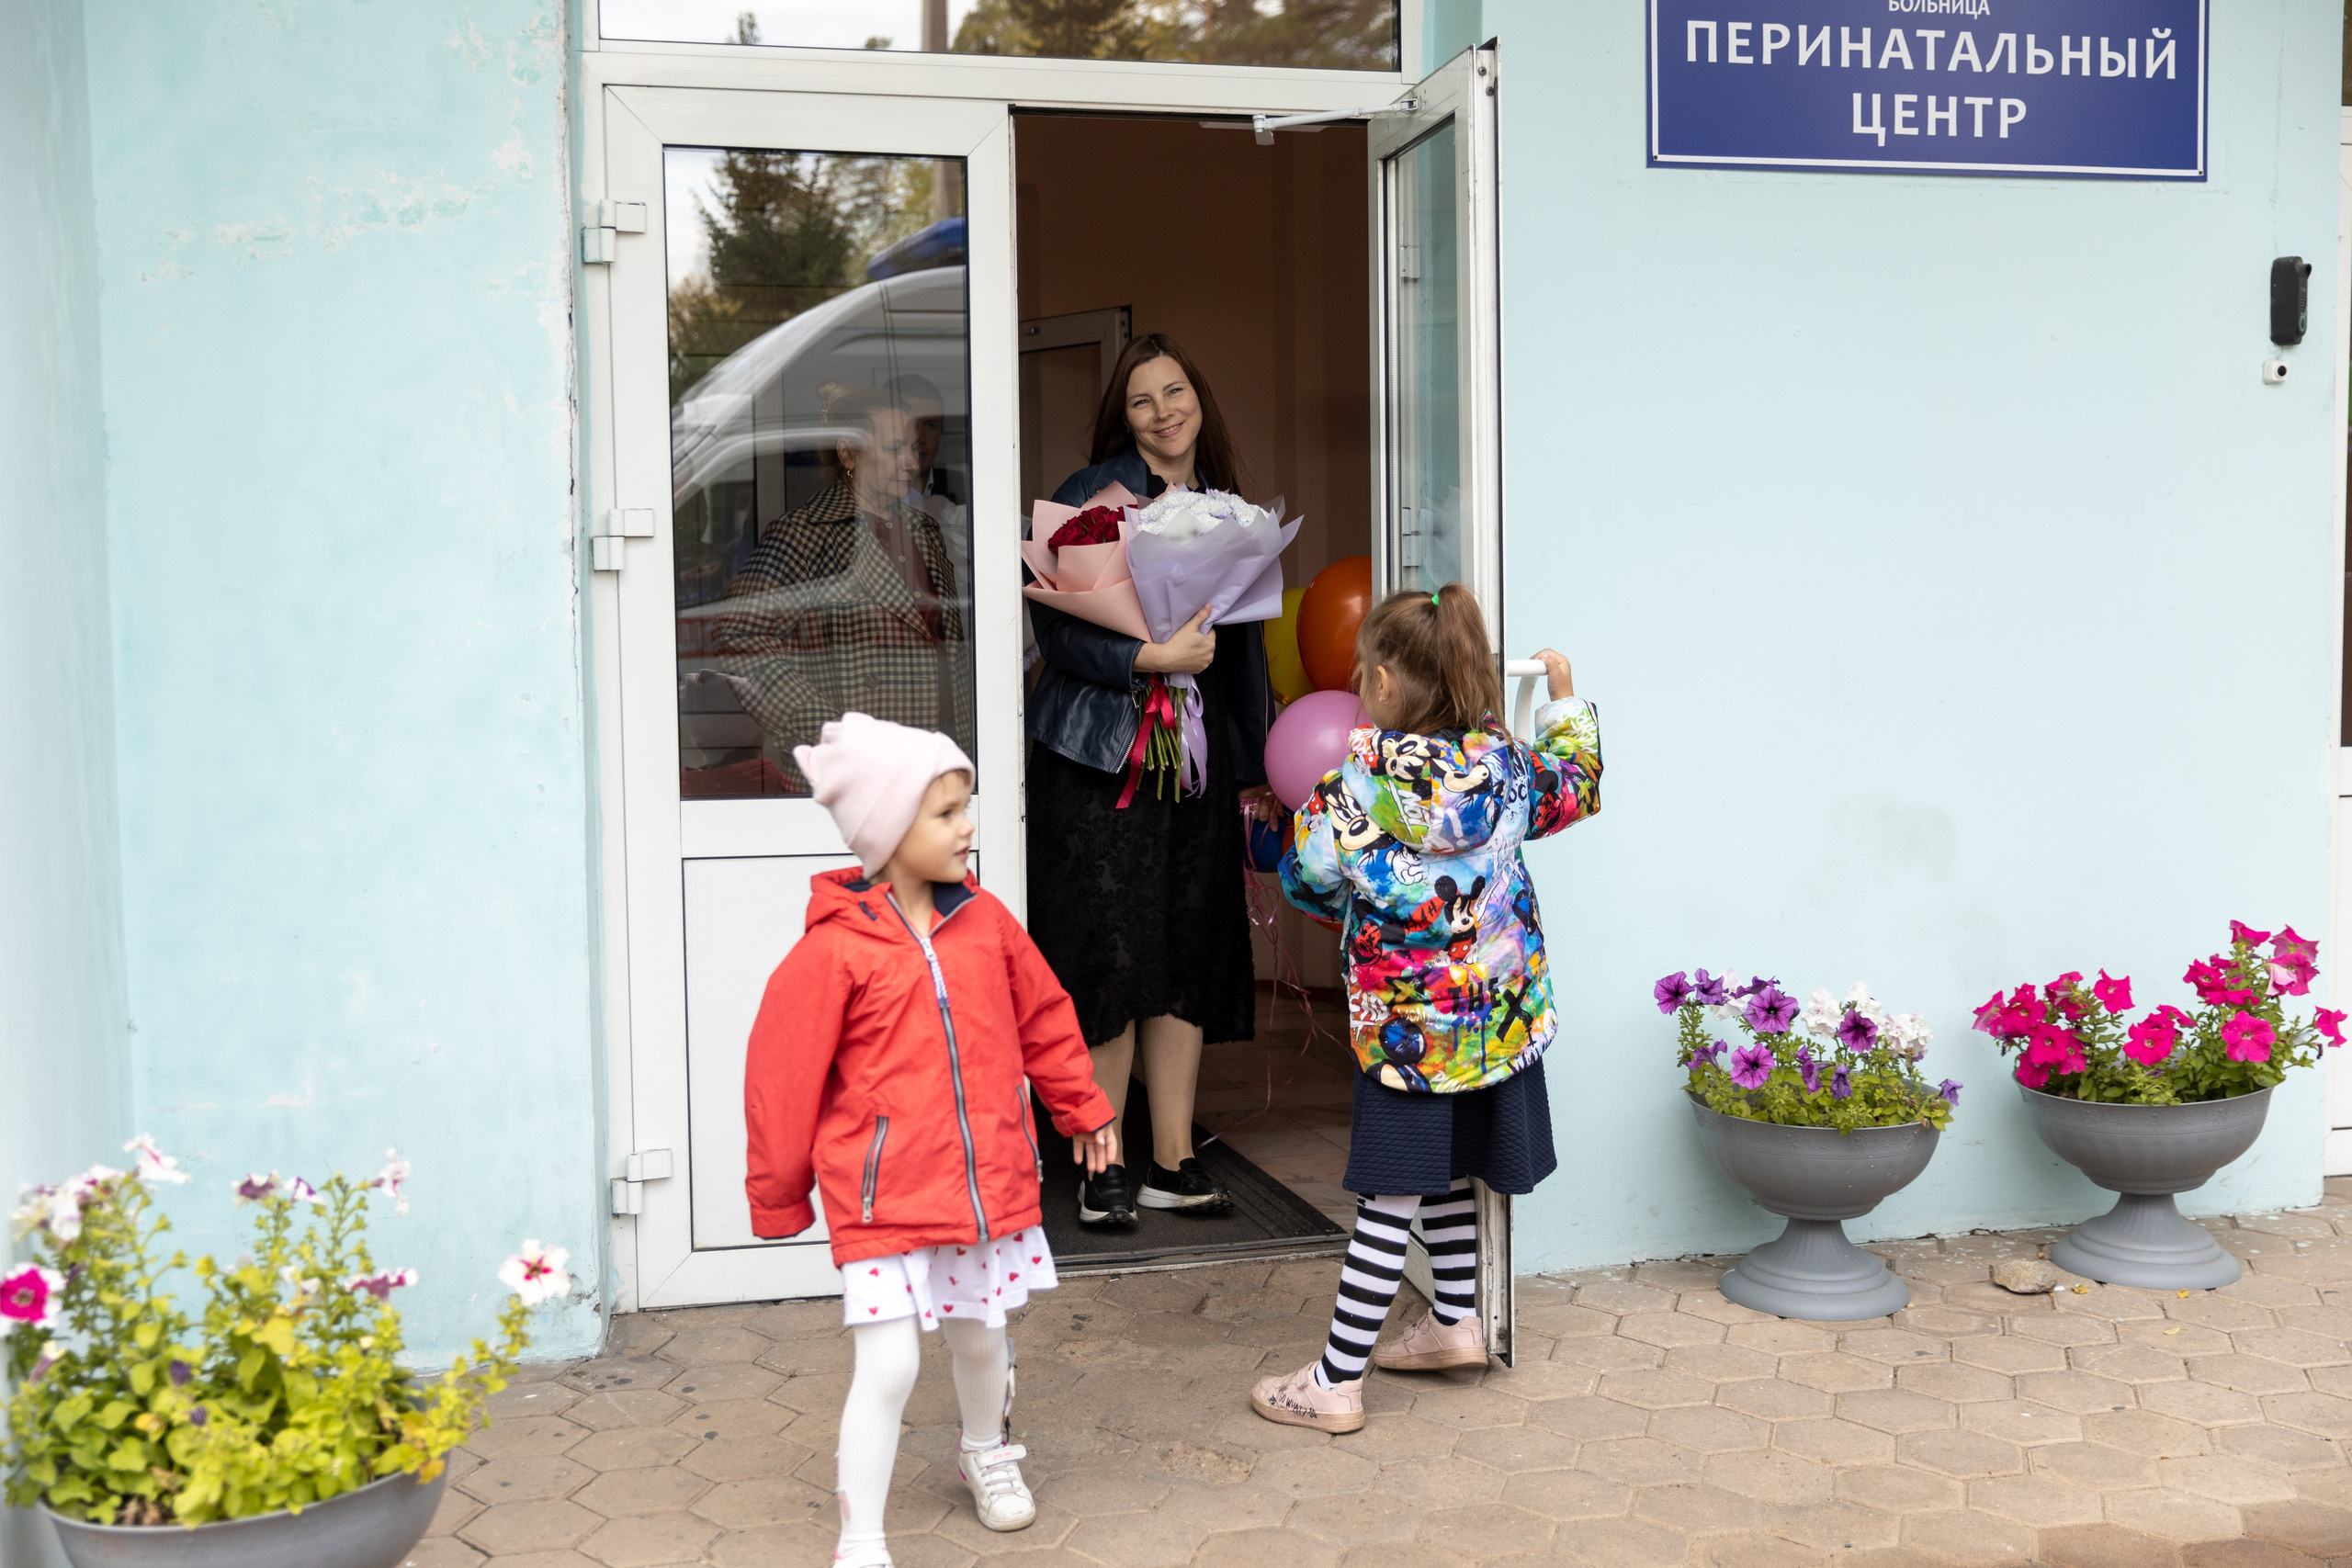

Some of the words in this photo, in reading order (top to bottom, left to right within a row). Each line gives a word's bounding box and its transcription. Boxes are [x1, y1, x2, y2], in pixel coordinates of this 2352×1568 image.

[1888, 0, 1991, 19] БОЛЬНИЦА
[1686, 20, 2177, 80] ПЕРИНАТАЛЬНЫЙ
[1852, 92, 2028, 147] ЦЕНТР
[1447, 976, 1502, 1015] THE
